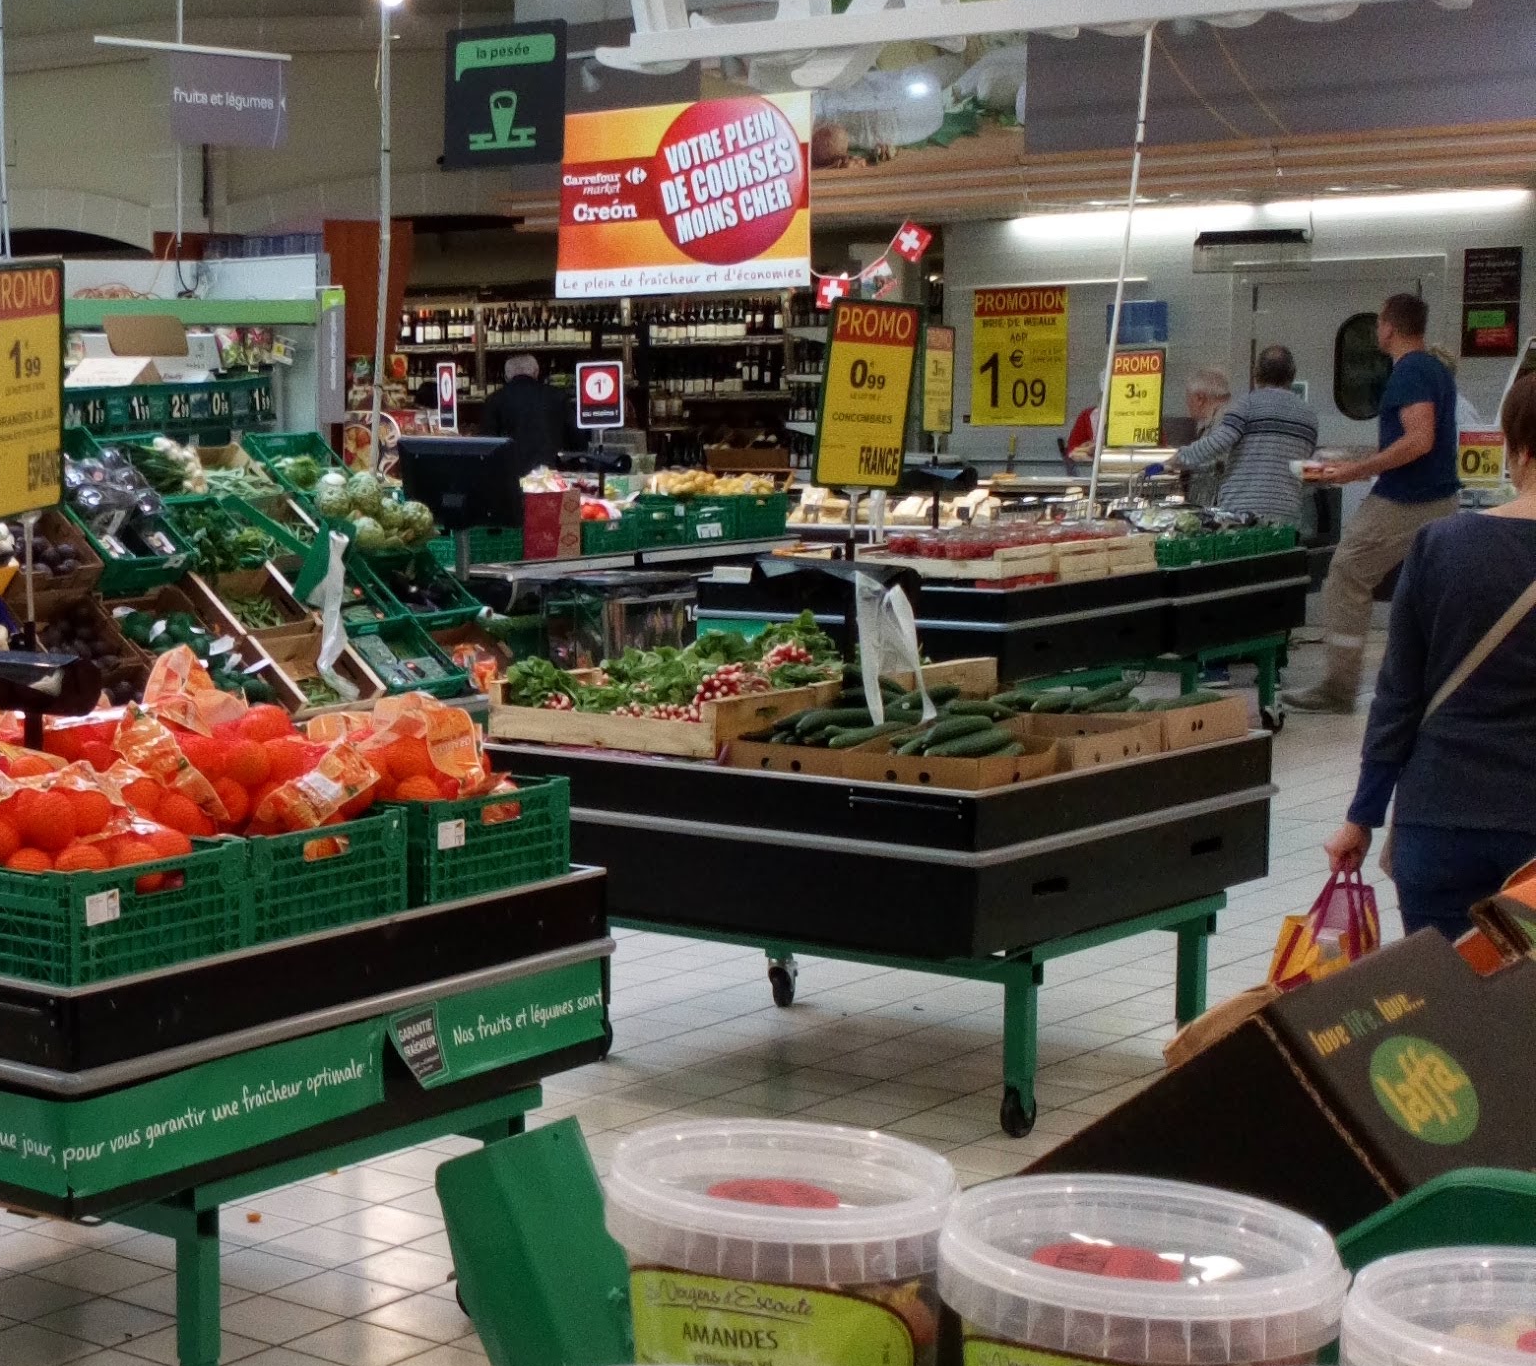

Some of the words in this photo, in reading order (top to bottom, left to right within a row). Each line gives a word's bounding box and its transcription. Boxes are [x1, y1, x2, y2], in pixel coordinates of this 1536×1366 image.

[475, 47, 486, 60] la
[489, 45, 530, 62] pesée
[173, 87, 208, 105] fruits
[211, 92, 224, 106] et
[226, 91, 274, 112] légumes
[664, 128, 725, 175] VOTRE
[722, 109, 777, 153] PLEIN
[562, 172, 621, 187] Carrefour
[582, 183, 621, 196] market
[660, 175, 692, 215] DE
[690, 137, 795, 204] COURSES
[573, 199, 638, 222] Creón
[675, 196, 739, 244] MOINS
[738, 178, 793, 222] CHER
[563, 278, 579, 291] Le
[584, 276, 616, 292] plein
[619, 273, 633, 288] de
[638, 271, 701, 290] fraîcheur
[705, 270, 718, 283] et
[724, 267, 802, 283] d'économies
[975, 291, 1064, 312] PROMOTION
[835, 306, 912, 340] PROMO
[1114, 355, 1160, 373] PROMO
[858, 445, 900, 476] FRANCE
[452, 1024, 475, 1048] Nos
[477, 1014, 513, 1039] fruits
[515, 1007, 528, 1028] et
[530, 1002, 574, 1029] légumes
[576, 988, 603, 1009] sont
[1307, 1024, 1352, 1058] love
[20, 1132, 57, 1164] jour,
[62, 1141, 105, 1170] pour
[109, 1127, 141, 1154] vous
[145, 1106, 207, 1149] garantir
[212, 1101, 239, 1123] une
[241, 1077, 303, 1110] fraîcheur
[307, 1060, 365, 1096] optimale
[682, 1321, 779, 1350] AMANDES
